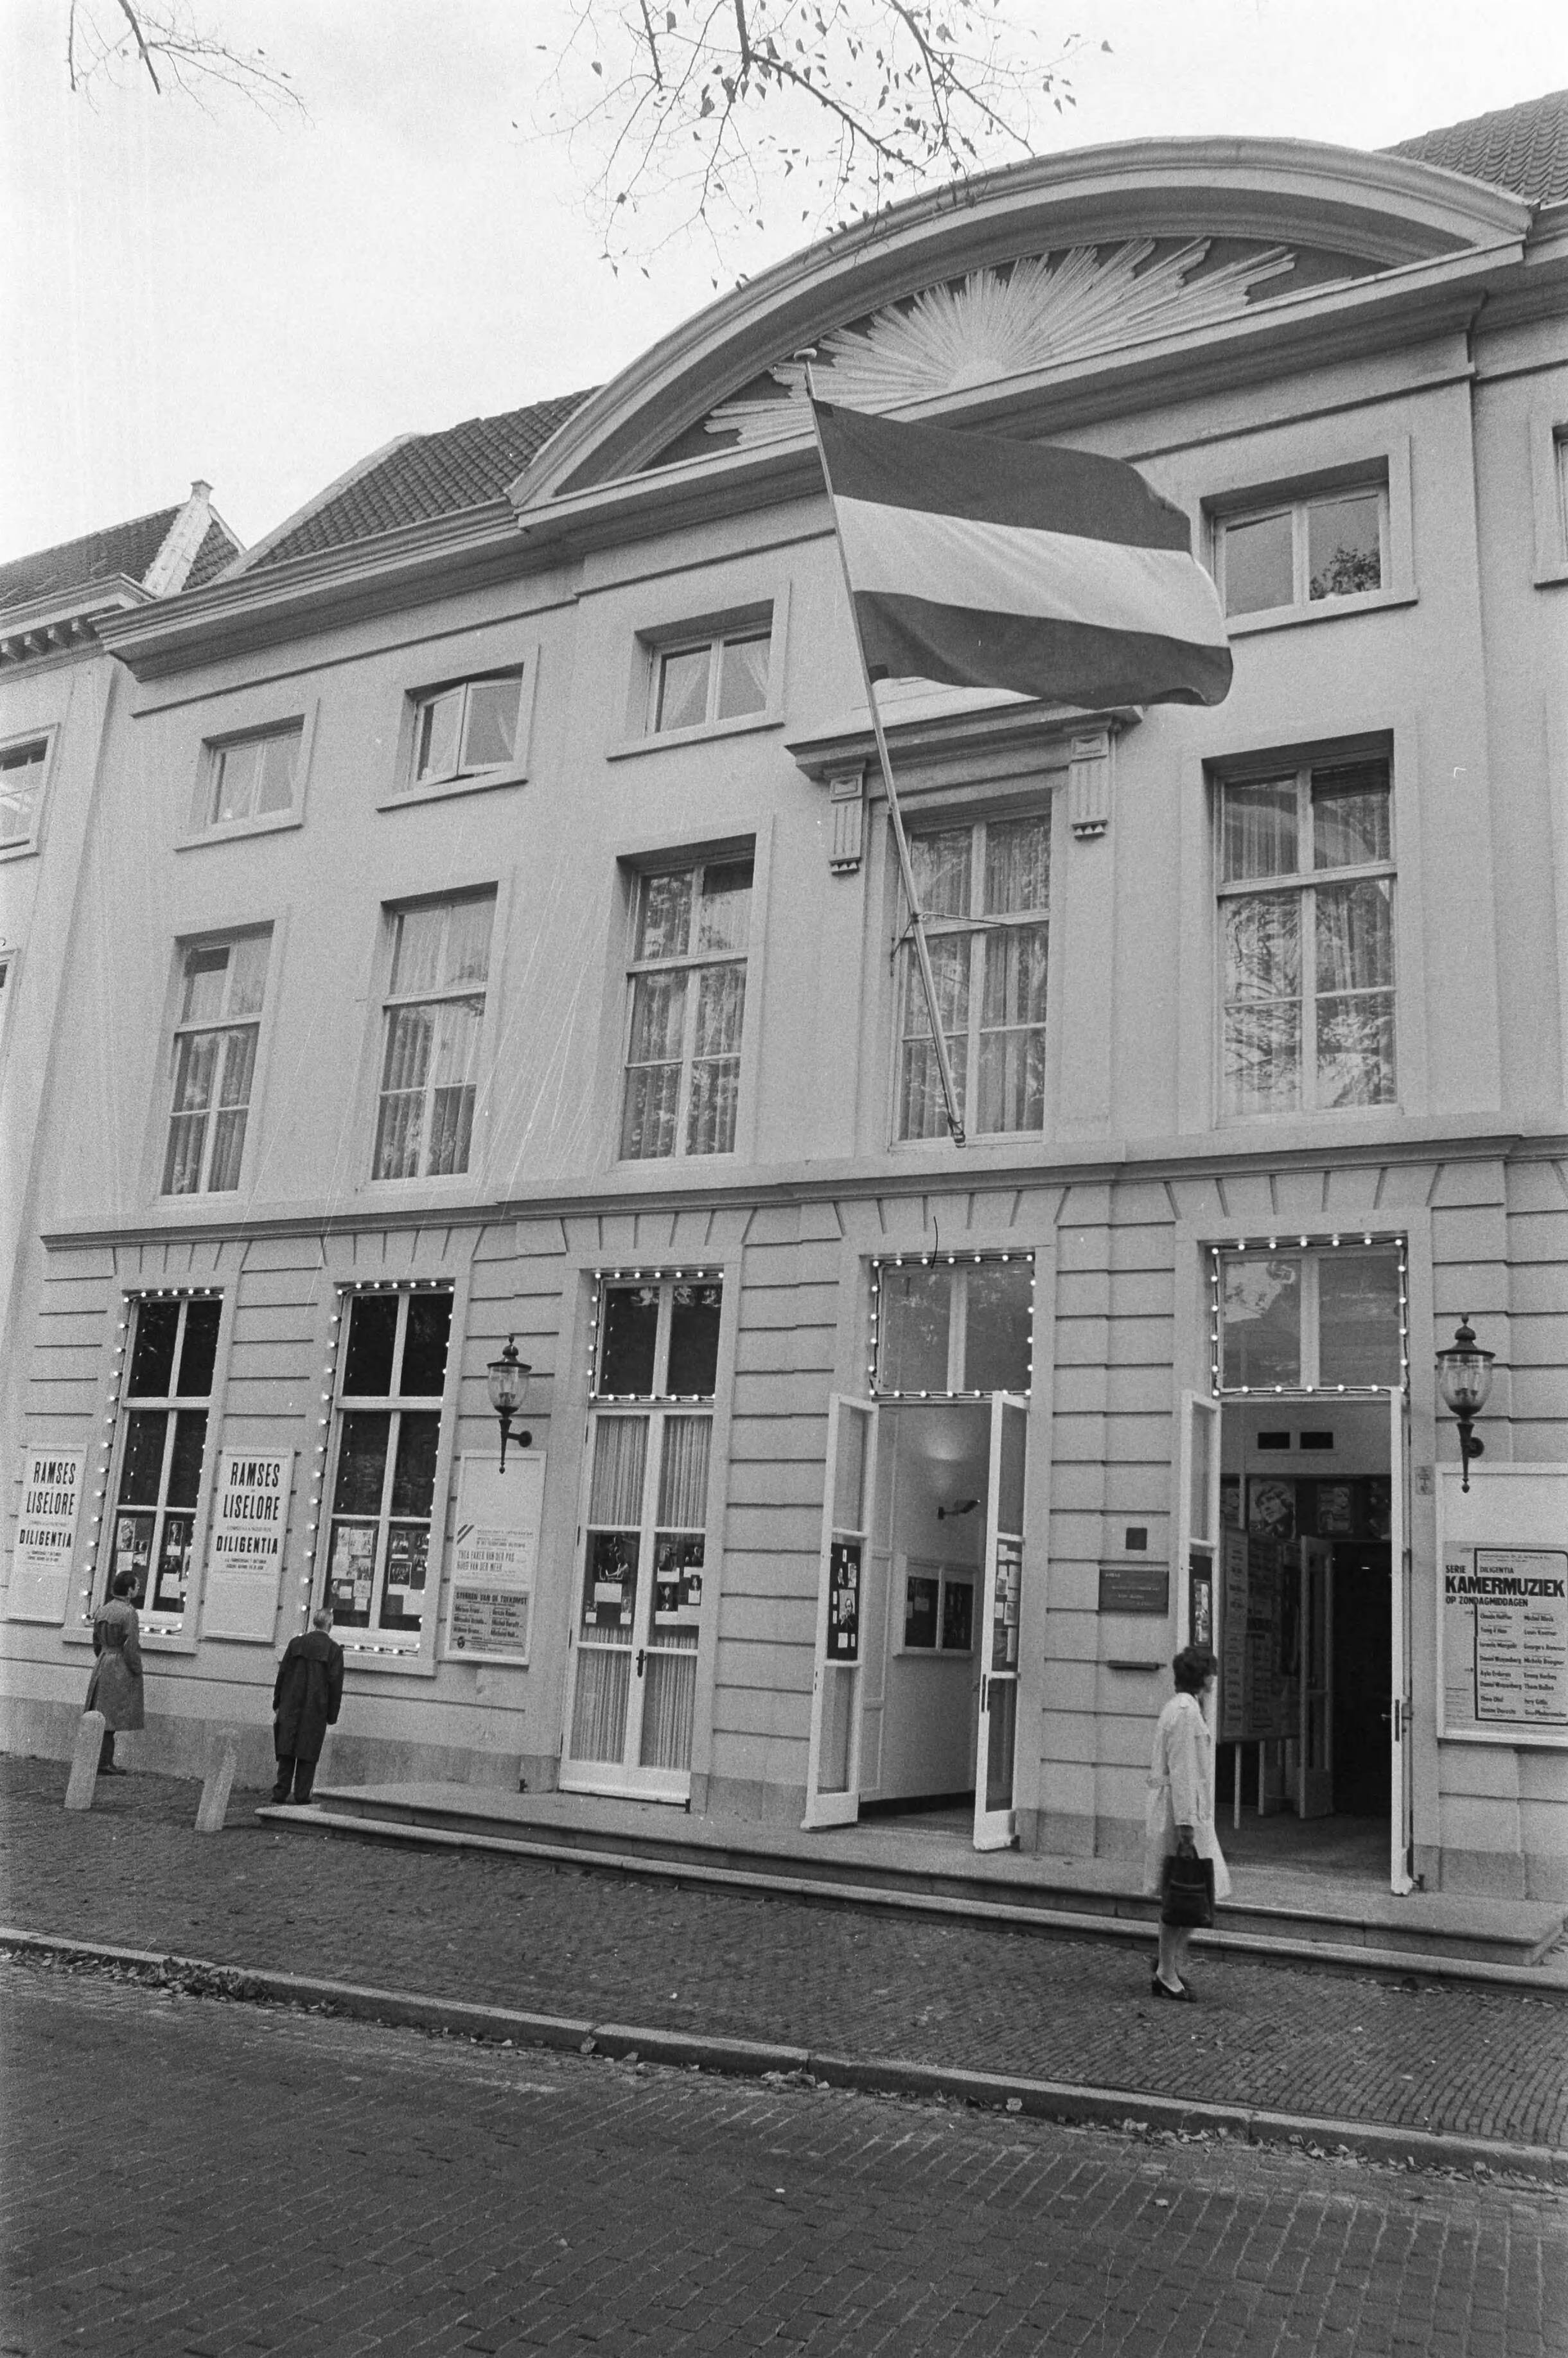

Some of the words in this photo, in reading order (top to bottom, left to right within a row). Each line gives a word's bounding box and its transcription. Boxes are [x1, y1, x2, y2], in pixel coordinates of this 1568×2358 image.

[33, 1461, 76, 1484] RAMSES
[230, 1462, 280, 1487] RAMSES
[26, 1491, 75, 1515] LISELORE
[223, 1494, 280, 1520] LISELORE
[19, 1529, 71, 1548] DILIGENTIA
[216, 1535, 277, 1554] DILIGENTIA
[1445, 1565, 1466, 1574] SERIE
[1445, 1576, 1565, 1598] KAMERMUZIEK
[1446, 1596, 1456, 1604] OP
[1459, 1596, 1528, 1606] ZONDAGMIDDAGEN
